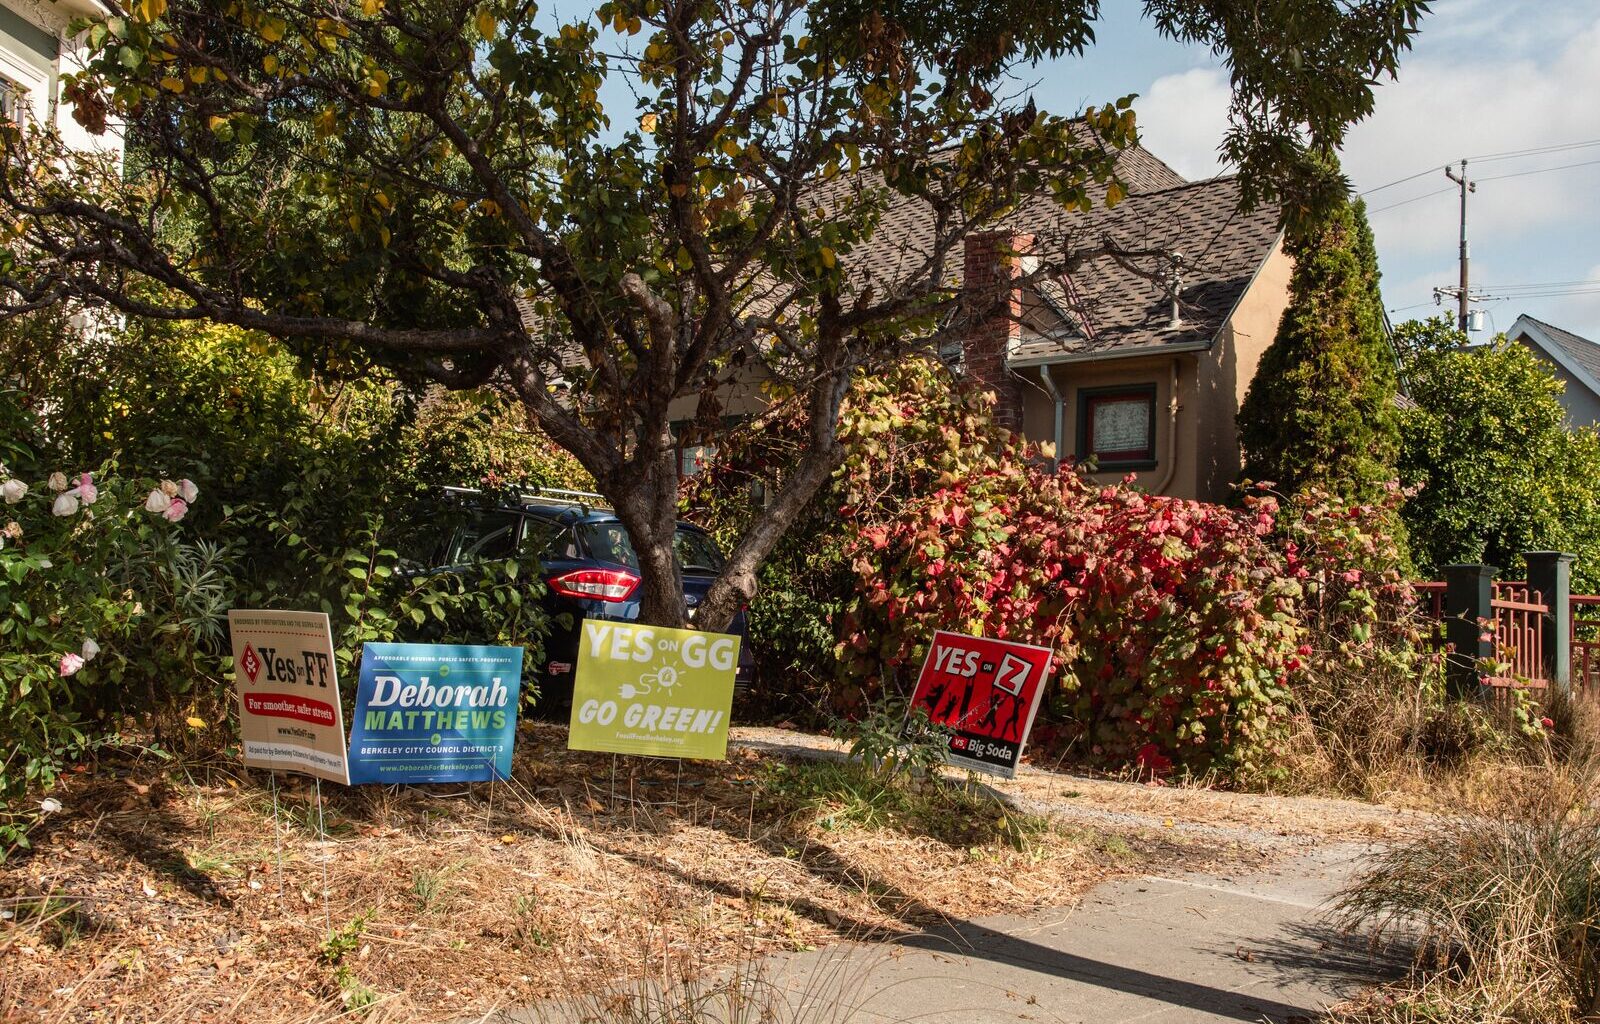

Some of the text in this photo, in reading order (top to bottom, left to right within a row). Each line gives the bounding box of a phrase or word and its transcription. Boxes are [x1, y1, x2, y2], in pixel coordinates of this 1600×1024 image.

[585, 623, 734, 671] YES ON GG
[258, 647, 329, 688] Yes on FF
[934, 645, 1026, 693] YES ON Z
[368, 675, 509, 708] Deborah
[248, 698, 333, 720] For smoother, safer streets
[364, 710, 507, 731] MATTHEWS
[579, 699, 724, 734] GO GREEN!
[361, 745, 503, 755] BERKELEY CITY COUNCIL DISTRICT 3
[955, 738, 1012, 760] vs. Big Soda
[380, 763, 485, 772] www.DeborahForBerkeley.com
